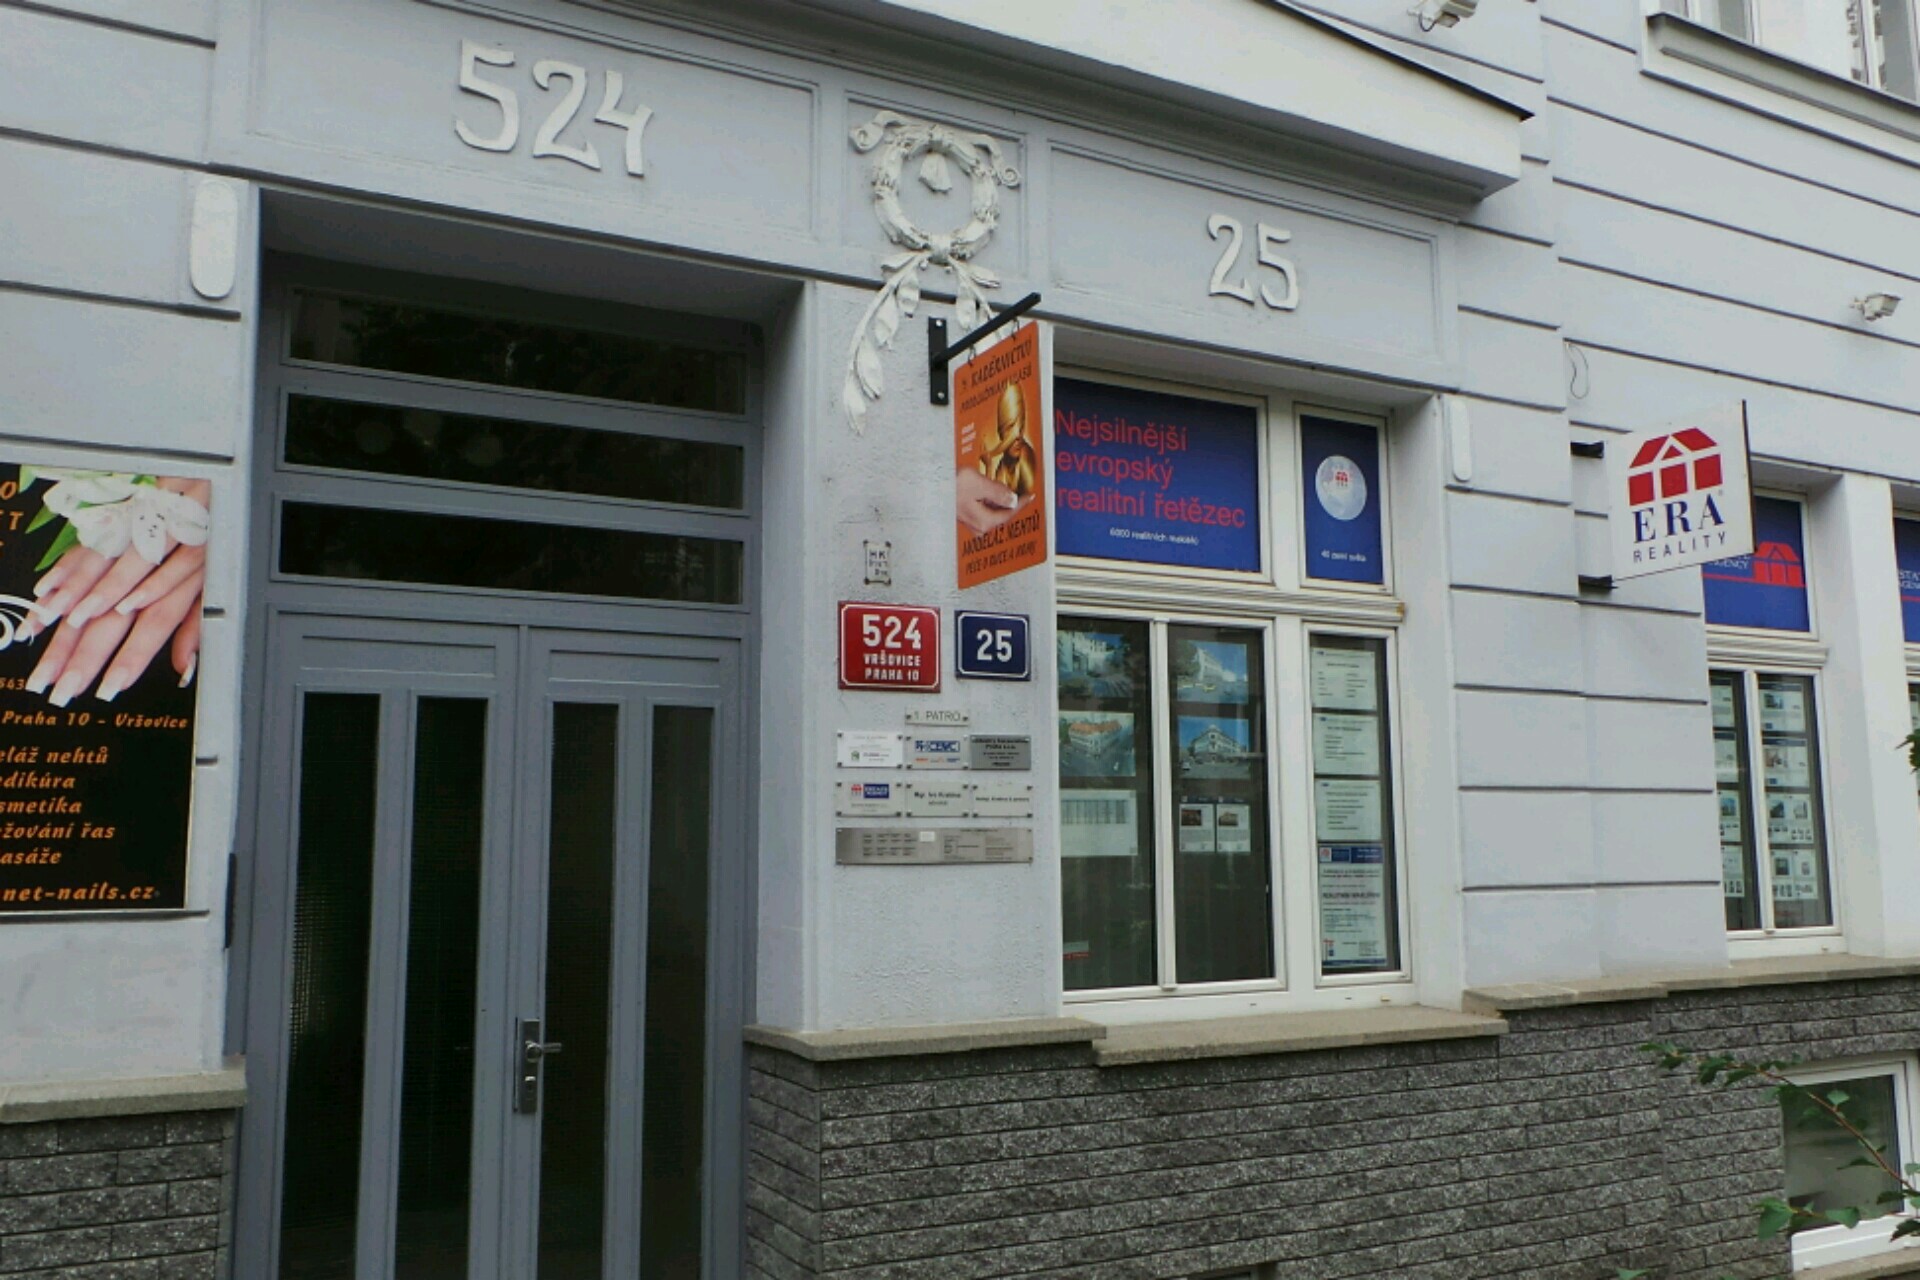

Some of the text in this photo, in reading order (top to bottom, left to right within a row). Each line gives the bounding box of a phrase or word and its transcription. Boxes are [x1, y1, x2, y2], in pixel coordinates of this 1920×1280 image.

[455, 38, 653, 178] 524
[1207, 213, 1299, 312] 25
[1056, 408, 1187, 455] Nejsilnější
[1056, 451, 1173, 490] evropský
[1058, 486, 1246, 528] realitní řetězec
[1631, 493, 1724, 543] ERA
[1633, 531, 1726, 563] REALITY
[862, 614, 922, 650] 524
[977, 629, 1012, 662] 25
[863, 649, 921, 667] VRŠOVICE
[864, 667, 920, 682] PRAHA 10
[2, 710, 57, 726] Praha
[67, 712, 91, 726] 10
[115, 713, 188, 729] Vršovice
[926, 711, 960, 722] PATRO
[47, 746, 109, 764] nehtů
[80, 822, 116, 839] řas
